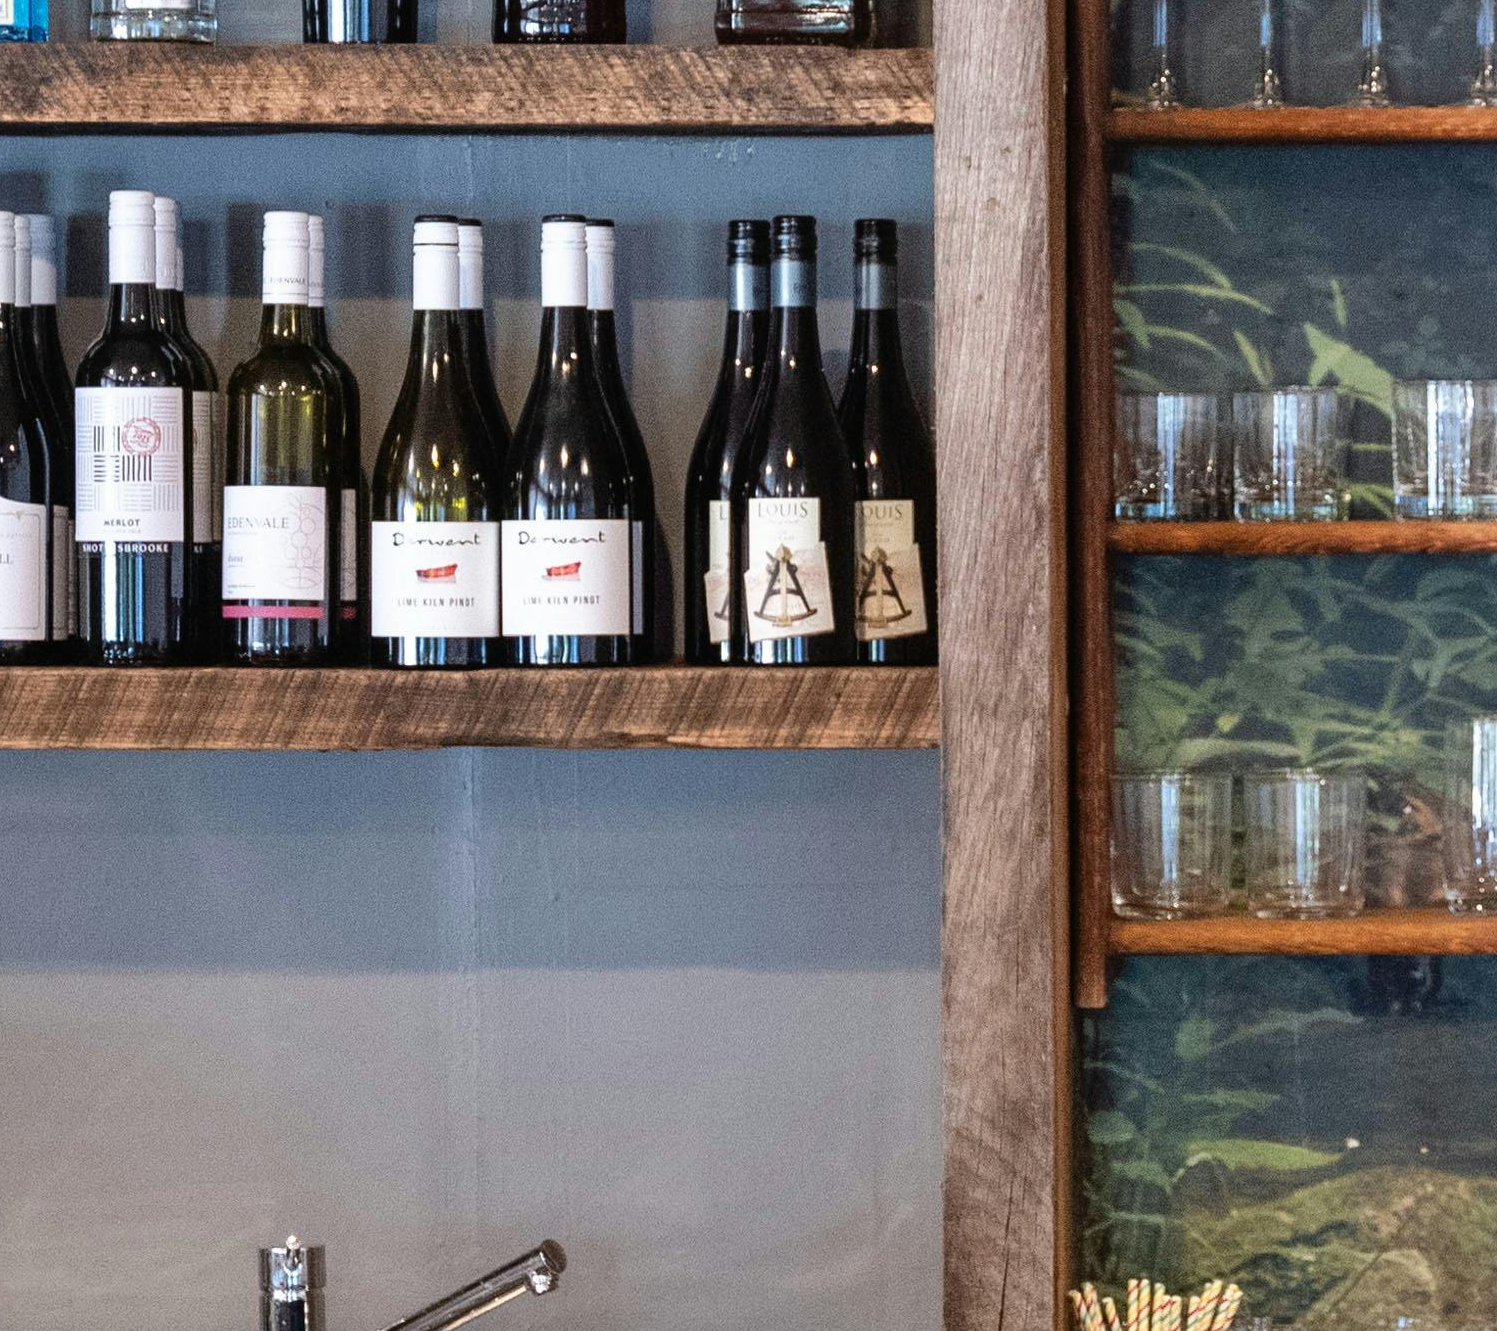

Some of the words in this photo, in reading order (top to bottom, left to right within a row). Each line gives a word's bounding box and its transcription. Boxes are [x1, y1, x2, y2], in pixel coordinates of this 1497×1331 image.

[758, 501, 809, 519] LOUIS
[861, 503, 904, 519] OUIS
[104, 519, 141, 527] MERLOT
[228, 516, 289, 529] EDENVALE
[393, 531, 481, 547] Drwent
[82, 543, 169, 553] SHOTSBROOKE
[397, 597, 418, 607] LIME
[422, 597, 446, 607] KILN
[449, 597, 476, 607] PINOT
[523, 595, 543, 605] LIME
[547, 595, 570, 605] KILN
[574, 595, 601, 605] PINOT
